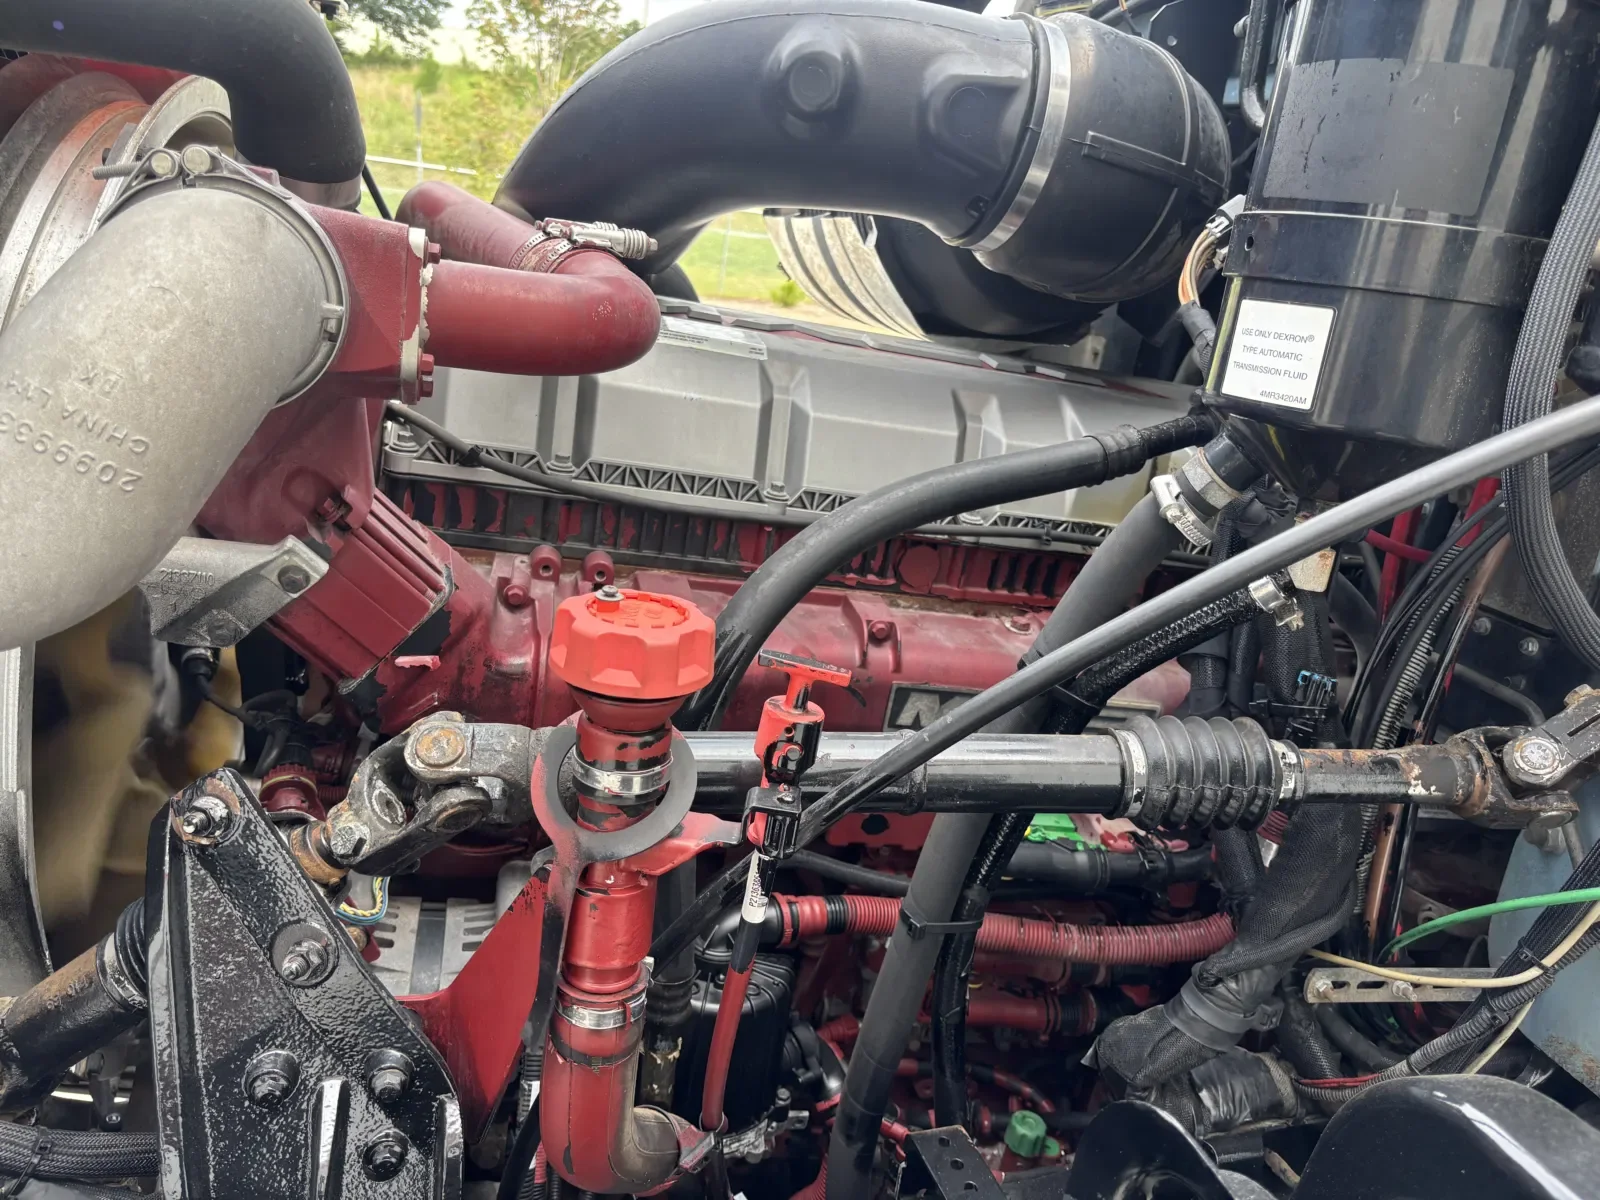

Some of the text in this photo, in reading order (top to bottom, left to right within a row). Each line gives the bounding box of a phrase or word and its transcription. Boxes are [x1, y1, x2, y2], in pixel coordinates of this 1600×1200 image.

[1241, 328, 1254, 336] USE
[1254, 329, 1272, 338] ONLY
[1242, 345, 1303, 361] TYPE AUTOMATIC
[1233, 361, 1308, 381] TRANSMISSION FLUID
[1259, 390, 1307, 405] 4MR3420AM
[62, 400, 150, 455] CHINA
